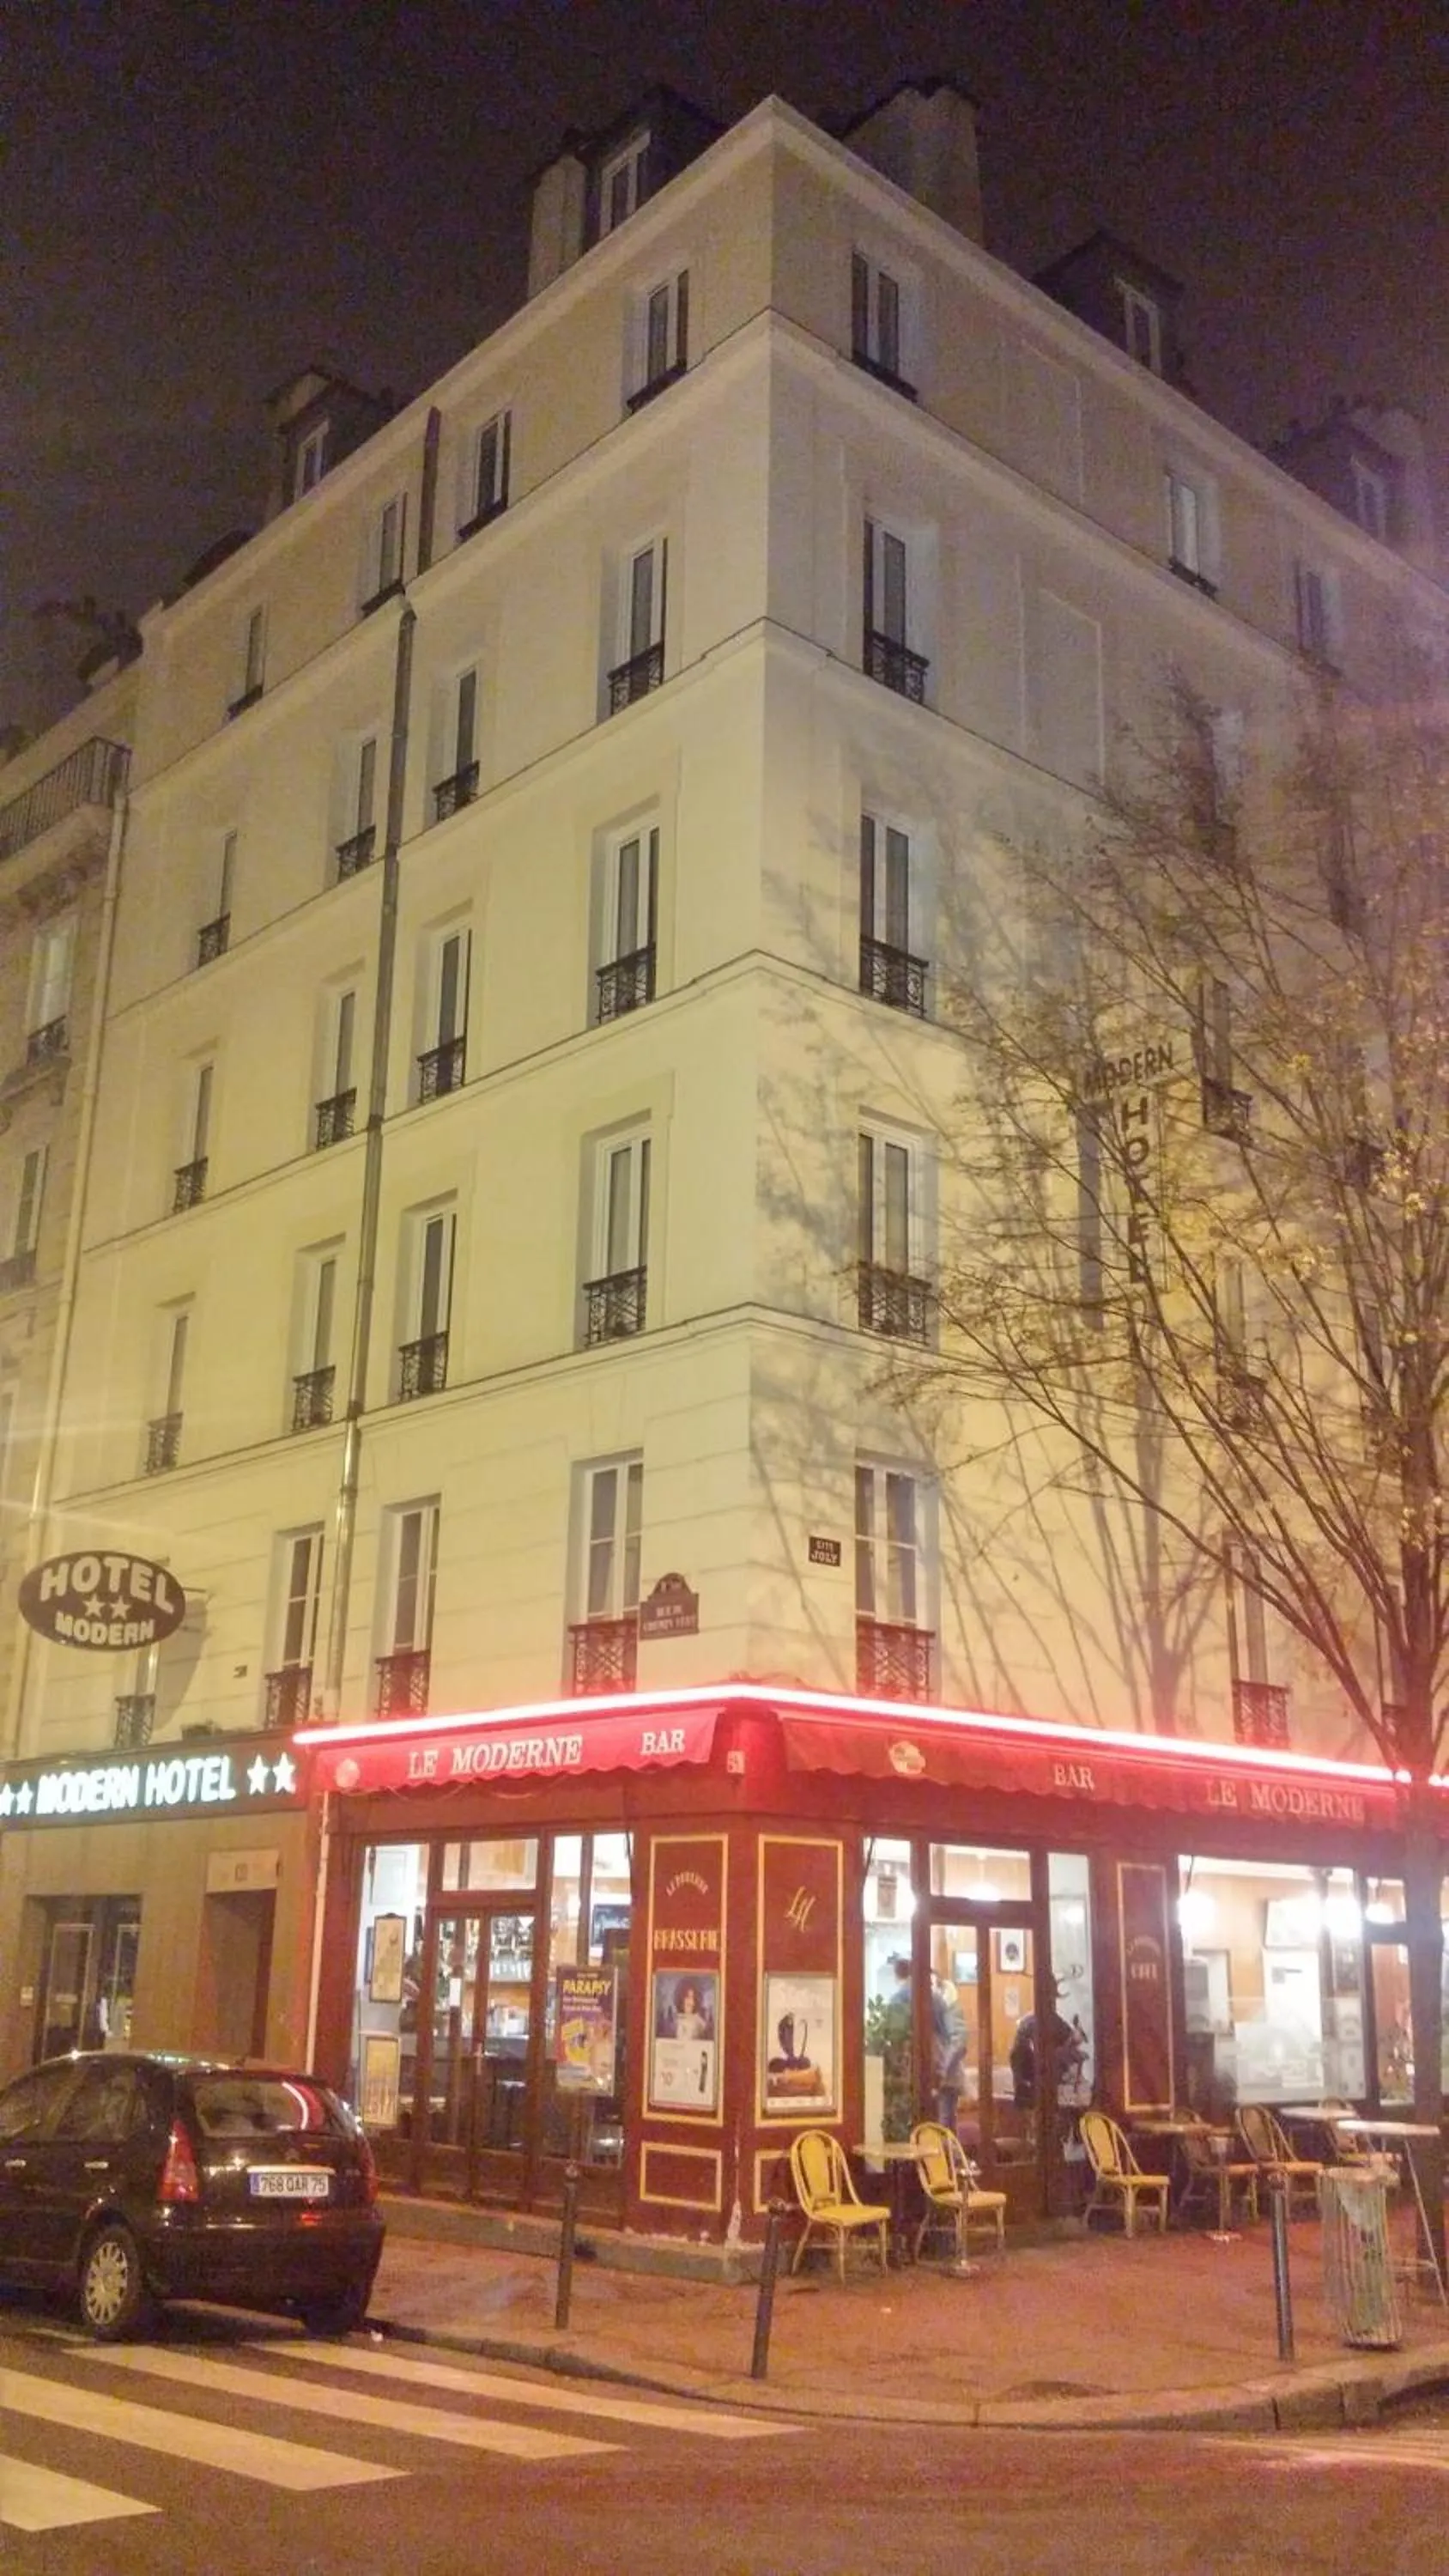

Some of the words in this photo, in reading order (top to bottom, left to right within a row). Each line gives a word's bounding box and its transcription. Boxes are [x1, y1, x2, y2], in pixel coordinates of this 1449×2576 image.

[810, 1549, 838, 1564] JOLY
[39, 1556, 174, 1613] HOTEL
[55, 1611, 155, 1645] MODERN
[407, 1749, 439, 1780] LE
[450, 1735, 584, 1776] MODERNE
[640, 1728, 686, 1756] BAR
[36, 1765, 140, 1814] MODERN
[145, 1755, 237, 1807] HOTEL
[1054, 1763, 1095, 1791] BAR
[1205, 1779, 1238, 1807] LE
[1249, 1783, 1366, 1822] MODERNE
[260, 2174, 284, 2192] 768
[311, 2176, 325, 2193] 75
